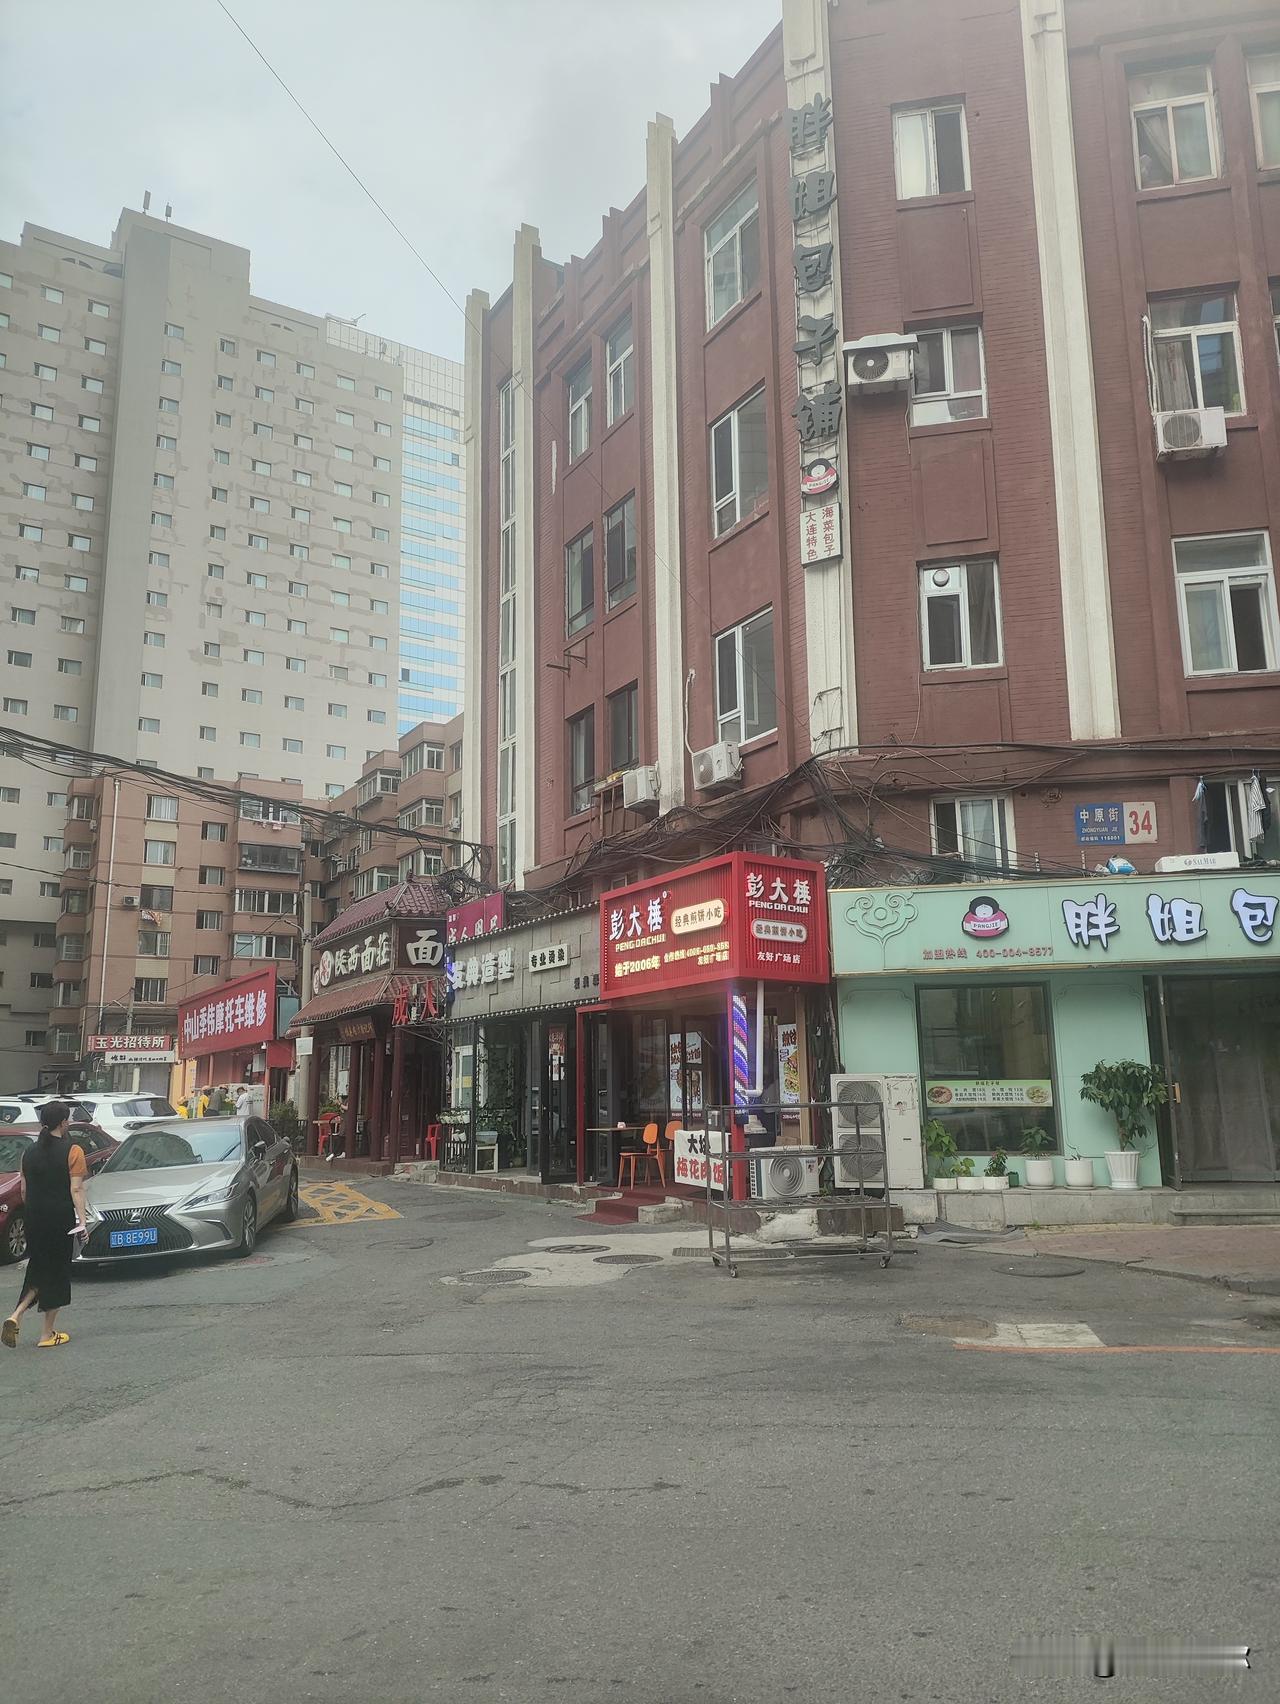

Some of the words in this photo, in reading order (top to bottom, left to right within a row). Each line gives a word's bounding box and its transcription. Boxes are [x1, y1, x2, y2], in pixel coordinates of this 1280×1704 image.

[785, 92, 842, 440] 胖姐包子铺
[804, 511, 818, 561] 大连特色
[821, 506, 835, 557] 海菜包子
[1079, 807, 1119, 824] 中原街
[1128, 810, 1153, 836] 34
[674, 906, 722, 928] 经典煎饼小吃
[748, 900, 773, 910] PENG
[972, 922, 1000, 930] PANGJIE
[1062, 888, 1279, 950] 胖姐包
[406, 929, 444, 966] 面
[756, 951, 801, 965] 友好广场店
[614, 955, 661, 978] 始于2006年
